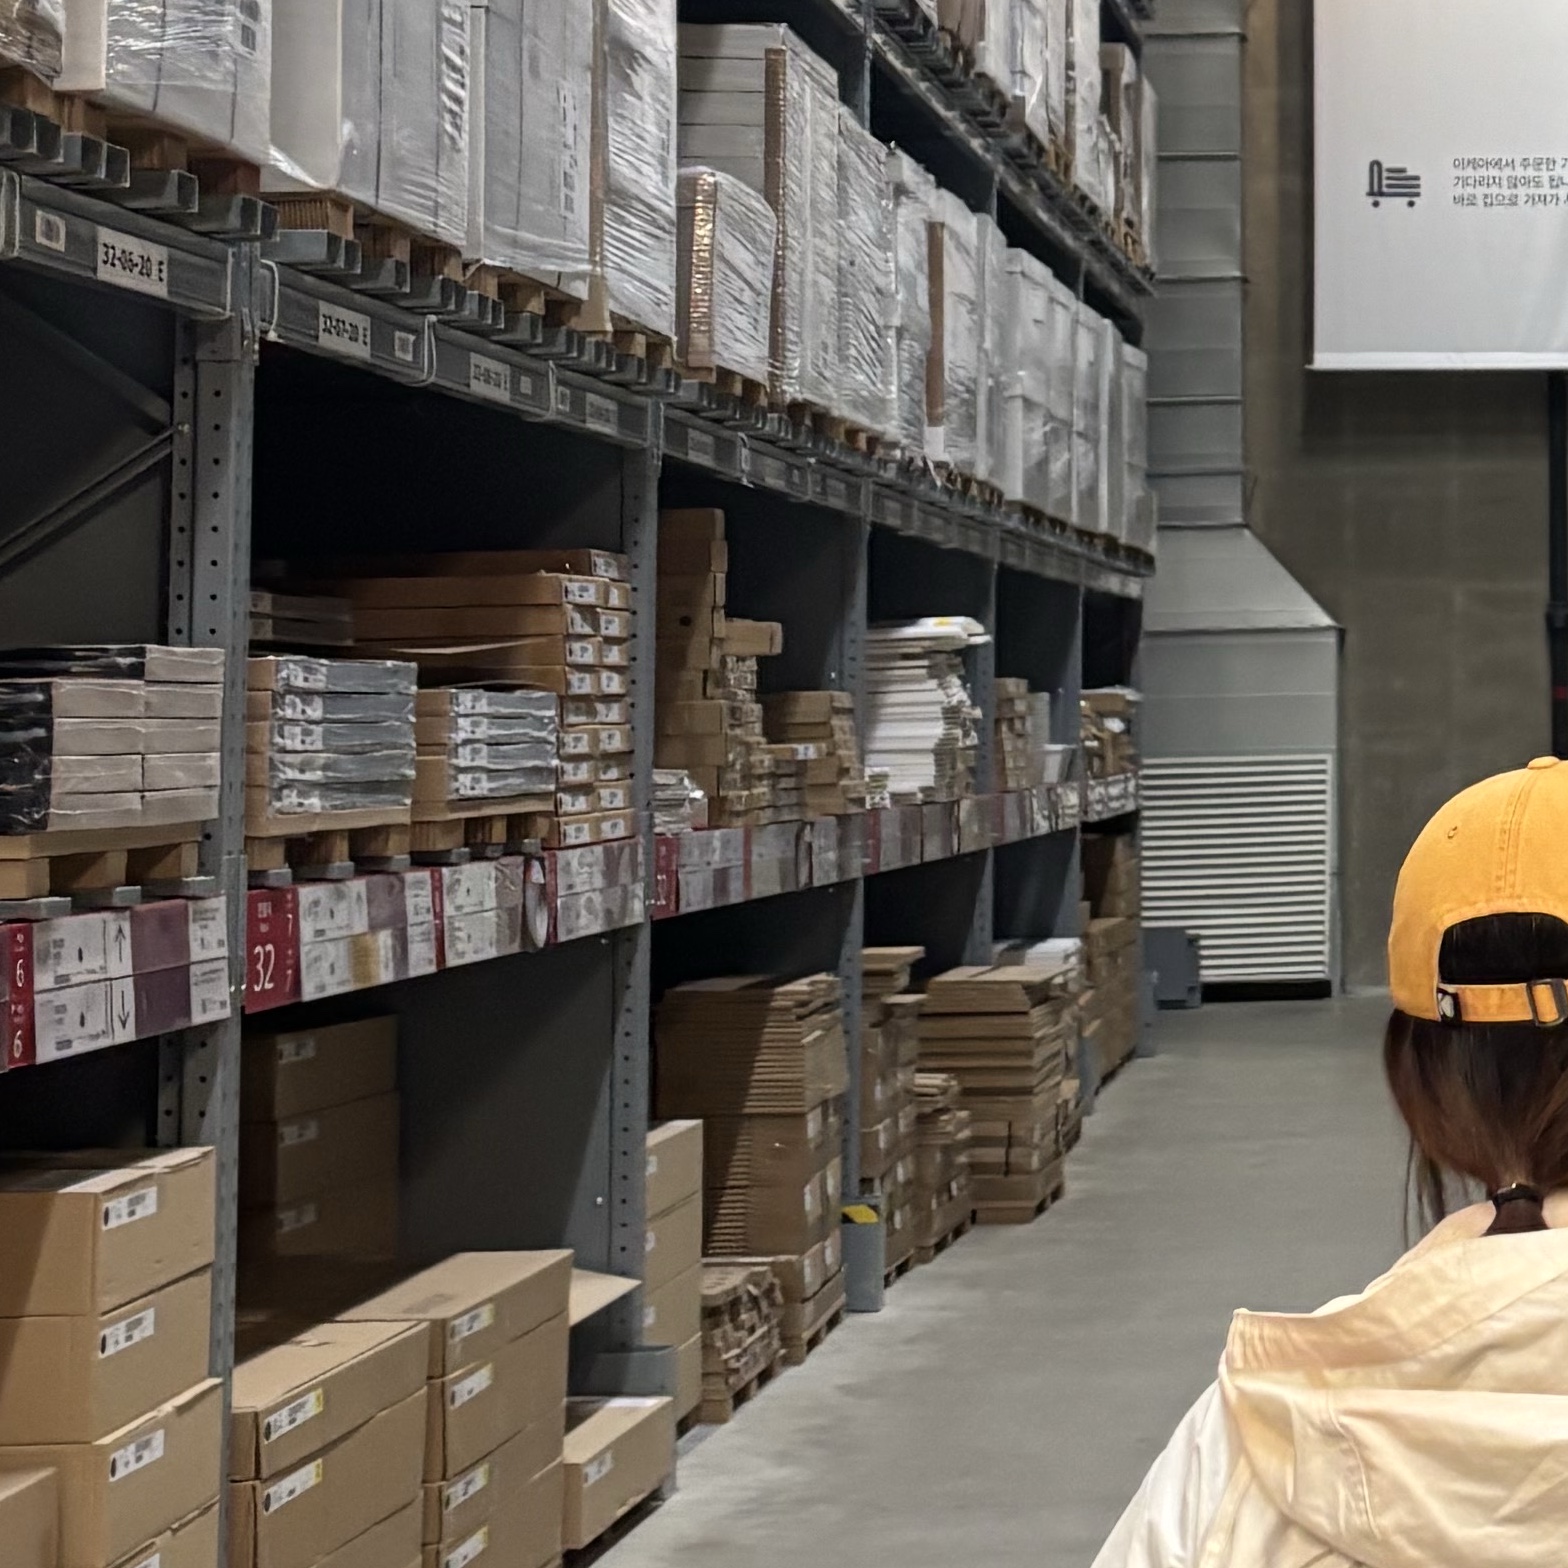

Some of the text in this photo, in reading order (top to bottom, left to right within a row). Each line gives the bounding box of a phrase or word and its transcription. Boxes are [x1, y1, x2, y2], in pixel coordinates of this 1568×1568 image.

[1453, 175, 1502, 190] 기다리지
[1453, 192, 1477, 207] 바로
[1482, 192, 1519, 207] 집으로
[102, 243, 151, 278] 32-06-20
[16, 958, 25, 988] 6
[253, 943, 276, 992] 32
[13, 1029, 23, 1059] 6
